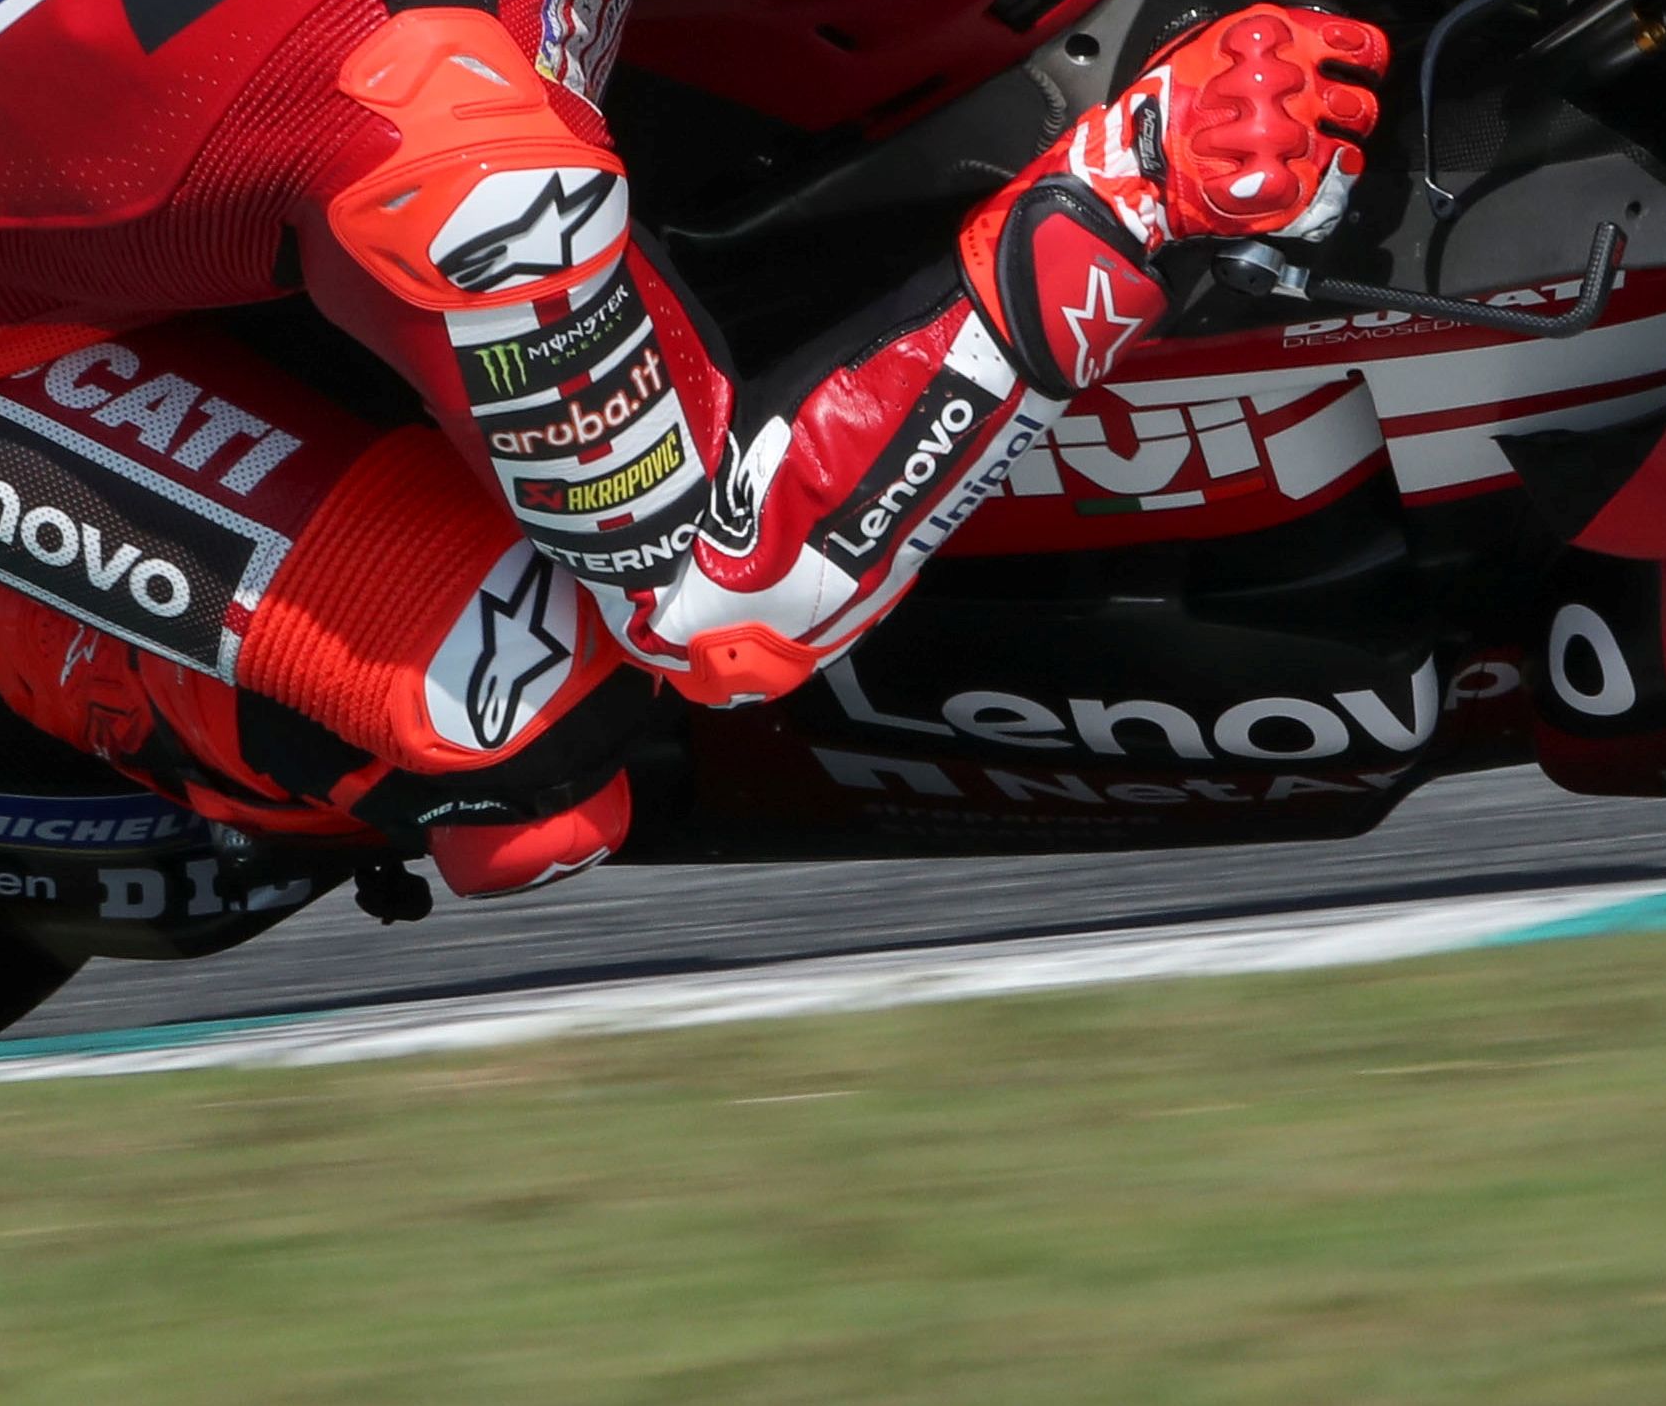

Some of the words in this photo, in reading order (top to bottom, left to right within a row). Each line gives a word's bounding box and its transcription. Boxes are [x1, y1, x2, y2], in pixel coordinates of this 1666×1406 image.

[528, 284, 629, 361] MONSTER
[14, 343, 306, 497] CATI
[490, 347, 660, 454] aruba.it
[829, 399, 973, 558] Lenovo
